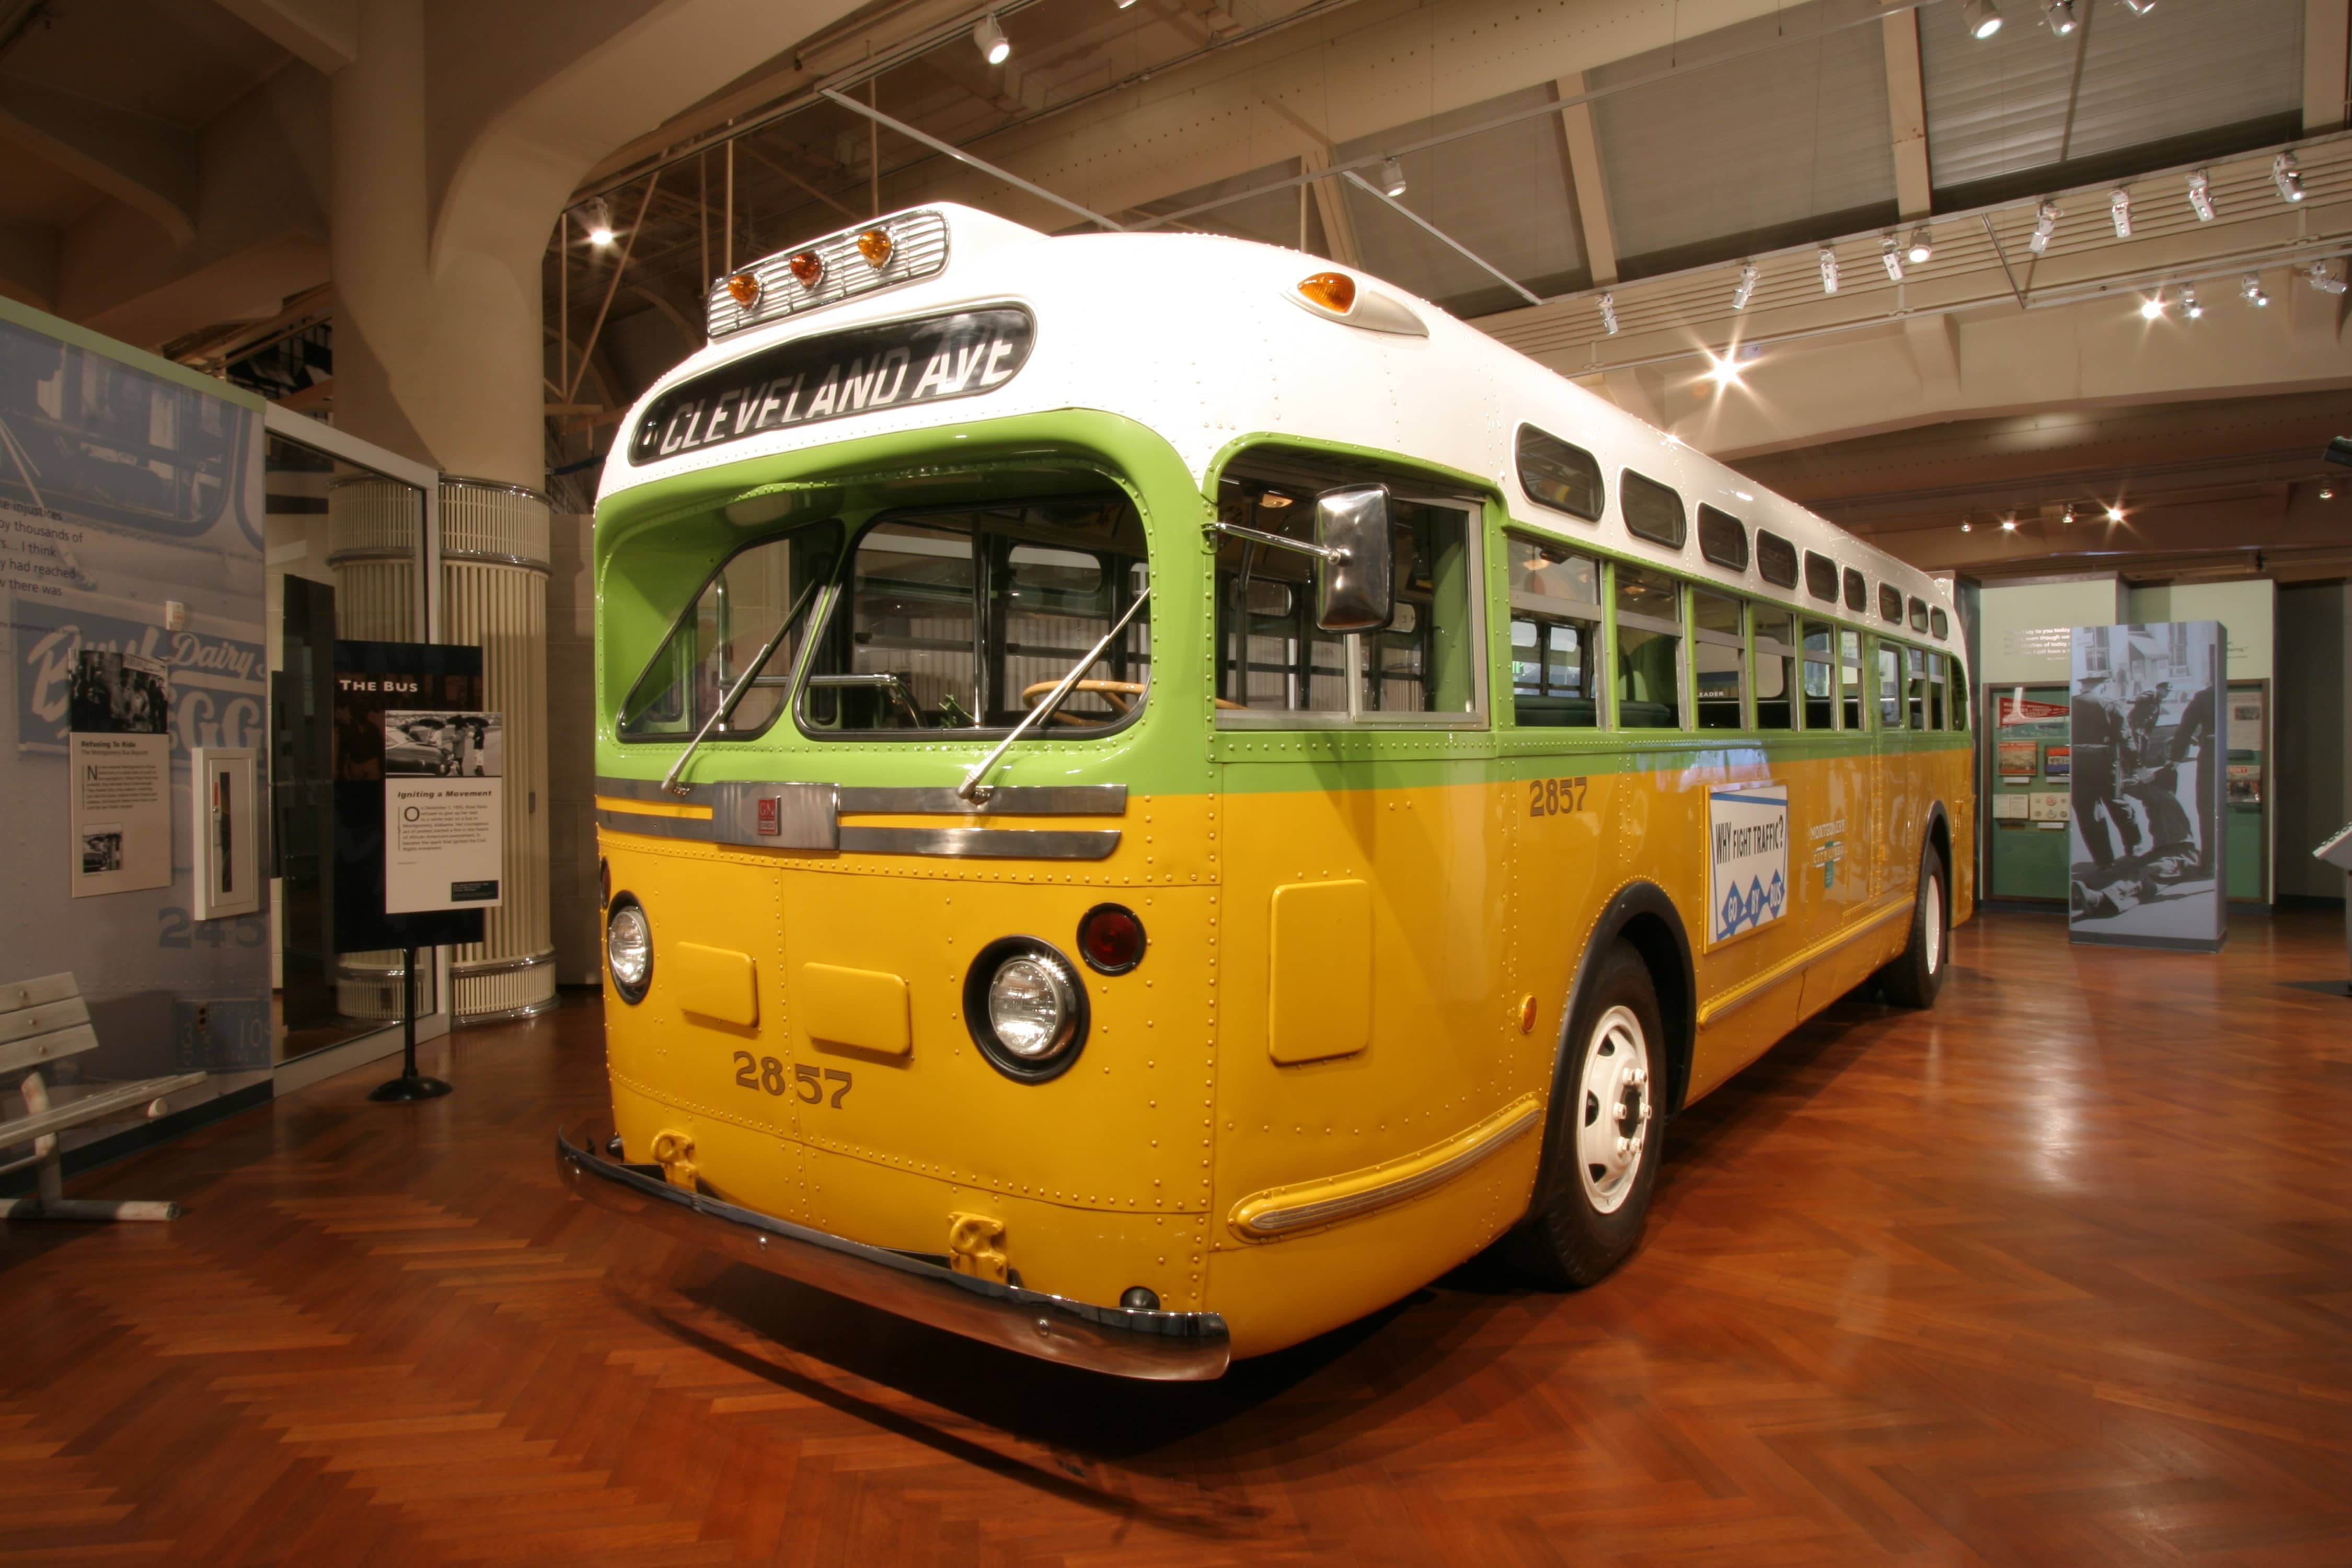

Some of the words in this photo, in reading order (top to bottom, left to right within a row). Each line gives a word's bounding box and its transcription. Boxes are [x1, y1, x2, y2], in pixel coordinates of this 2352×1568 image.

[660, 347, 909, 455] CLEVELAND
[912, 329, 1013, 398] AVE
[13, 503, 63, 521] injustices
[14, 521, 69, 541] thousands
[72, 532, 84, 543] of
[28, 543, 56, 557] think
[9, 558, 30, 572] had
[34, 564, 76, 579] reached
[9, 579, 39, 593] there
[42, 584, 62, 596] was
[168, 631, 255, 679] Dairy
[340, 680, 376, 690] THE
[384, 682, 418, 692] BUS
[397, 791, 434, 799] Igniting
[1530, 777, 1587, 817] 2857
[1715, 821, 1732, 864] WHY
[1733, 827, 1752, 859] FIGHT
[1753, 814, 1784, 855] TRAFFIC?
[1727, 896, 1737, 923] GO
[1750, 888, 1760, 915] BY
[1769, 881, 1782, 908] BUS
[733, 1050, 852, 1110] 2857
